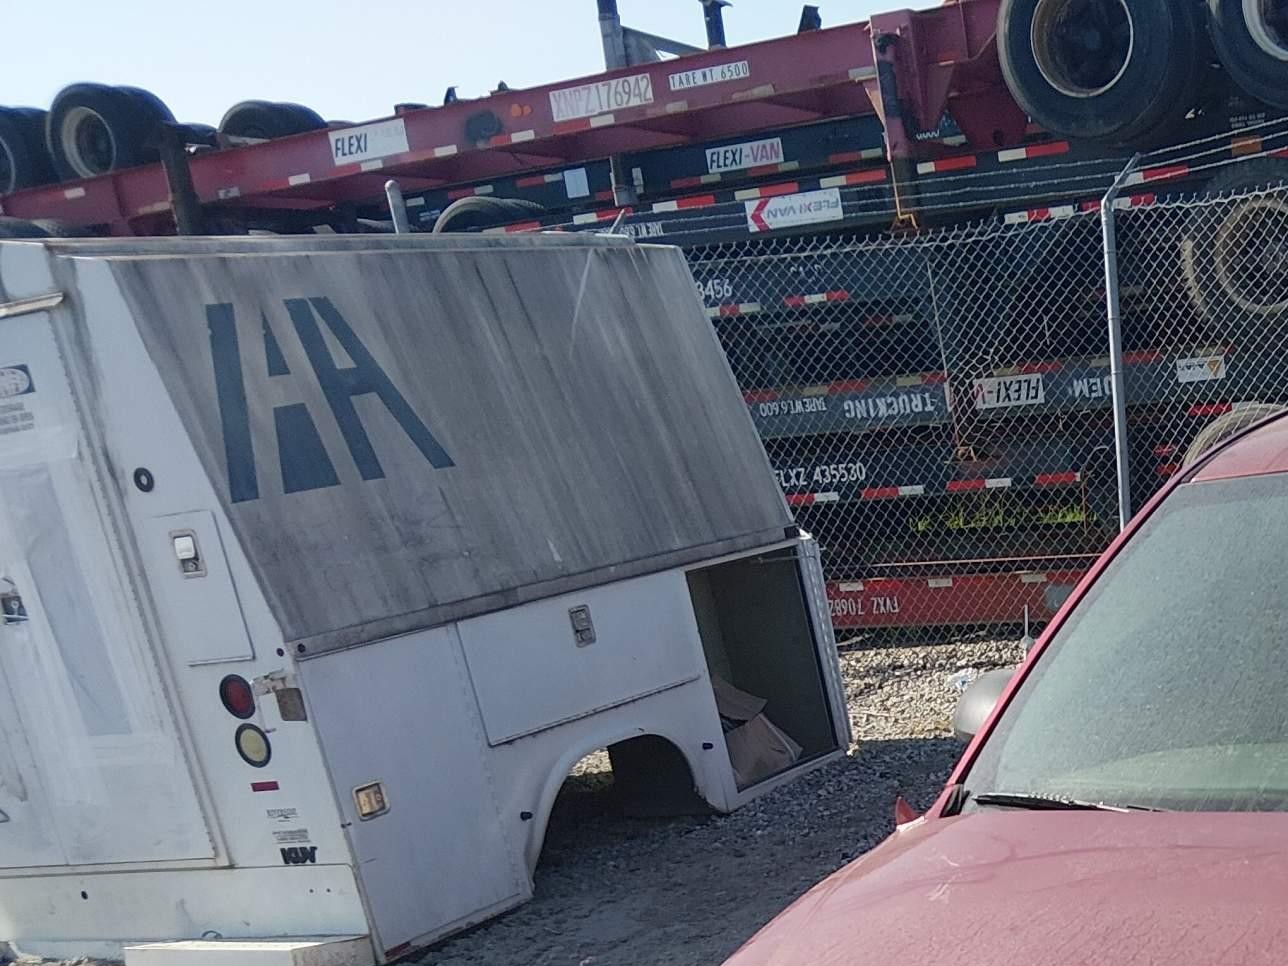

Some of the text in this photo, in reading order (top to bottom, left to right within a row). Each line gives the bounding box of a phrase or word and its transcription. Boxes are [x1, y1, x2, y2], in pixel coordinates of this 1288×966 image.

[670, 71, 697, 89] TARE
[720, 62, 748, 79] 6500
[334, 132, 368, 158] FLEXI
[709, 142, 780, 170] FLEXI-VAN
[767, 197, 839, 219] FLEXI VAN
[843, 392, 936, 419] TRUCKING
[870, 595, 900, 615] FVXZ
